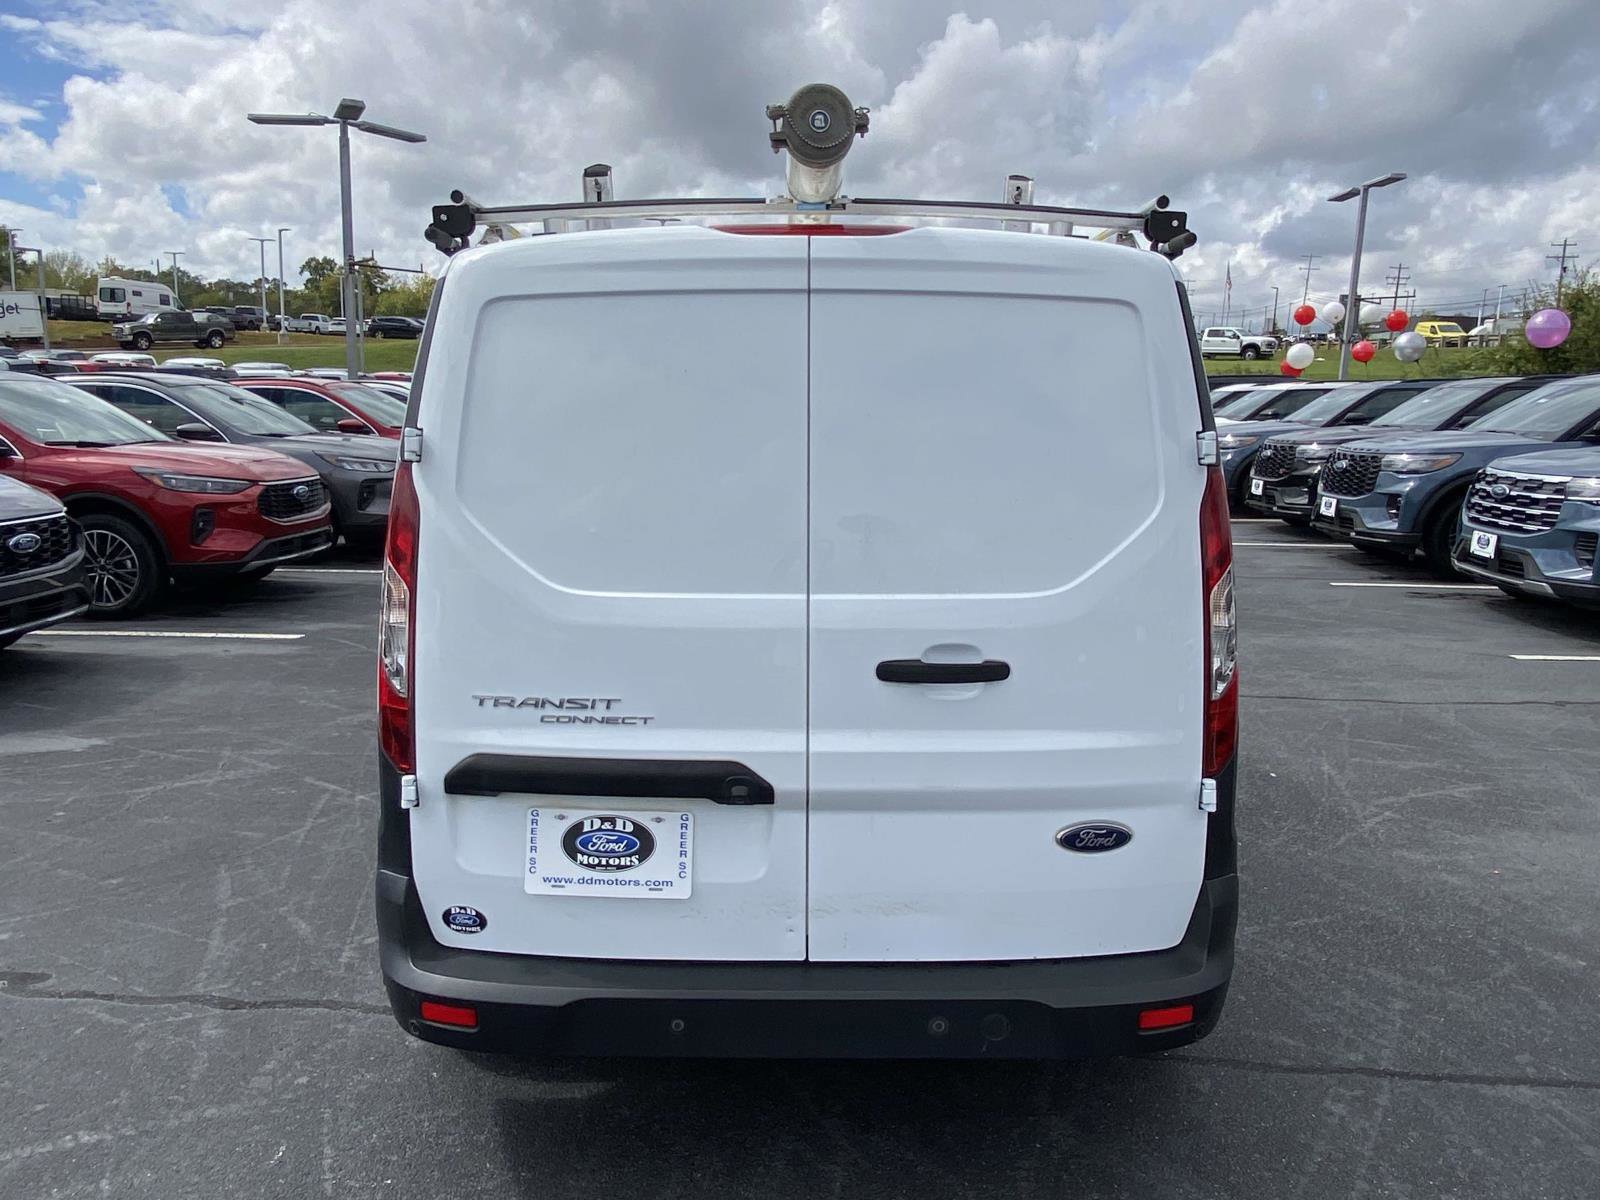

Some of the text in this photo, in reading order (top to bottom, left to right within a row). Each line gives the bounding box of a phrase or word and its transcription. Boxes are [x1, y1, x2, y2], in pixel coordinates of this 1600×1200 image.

[472, 694, 622, 711] TRANSIT
[540, 714, 655, 726] CONNECT
[582, 817, 634, 833] D&D
[529, 809, 540, 874] GREER SC
[588, 834, 627, 852] Ford
[678, 813, 689, 879] GREER SC
[1075, 829, 1117, 847] Ford
[576, 852, 640, 867] MOTORS
[542, 875, 674, 888] www.ddmotors.com
[450, 923, 481, 932] MOTORS
